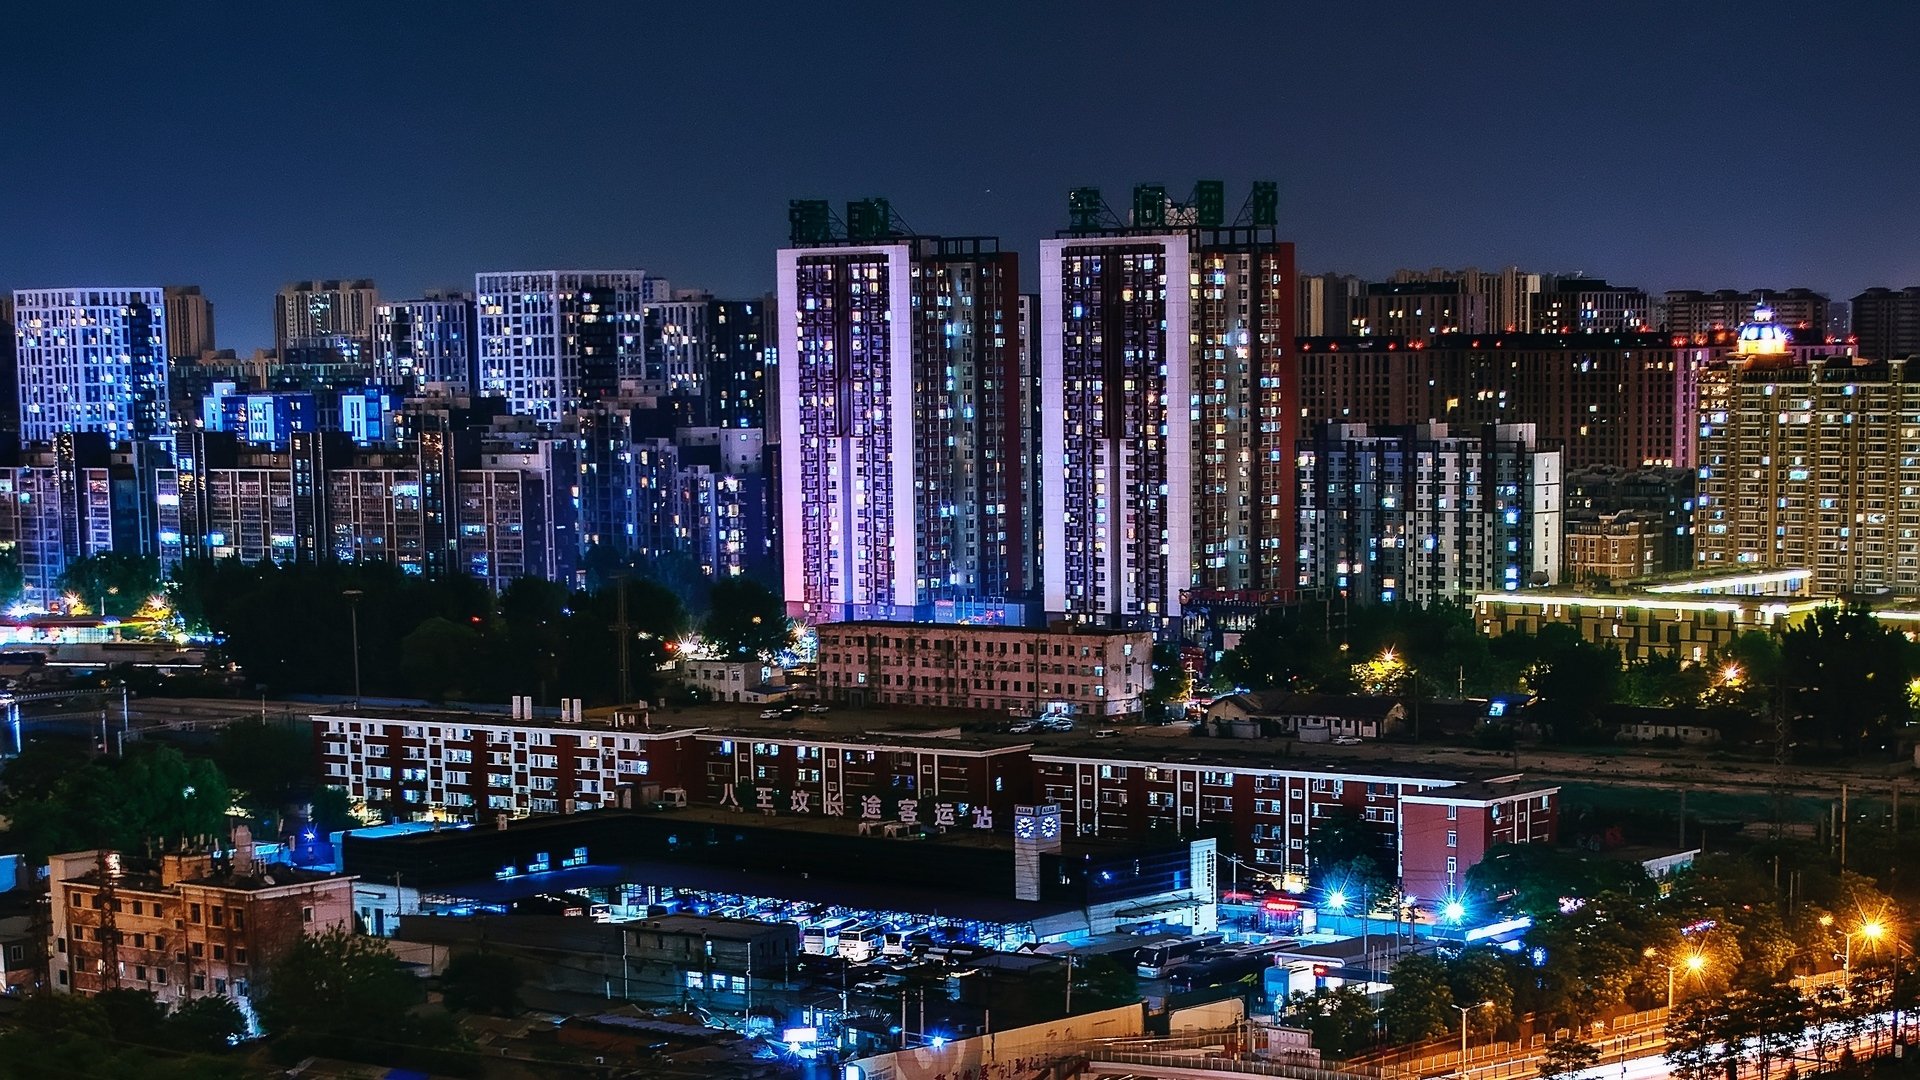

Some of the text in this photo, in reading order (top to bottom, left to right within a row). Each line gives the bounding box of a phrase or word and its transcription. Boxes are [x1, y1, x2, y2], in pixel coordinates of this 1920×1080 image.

[719, 783, 993, 830] 八王坟长途客运站
